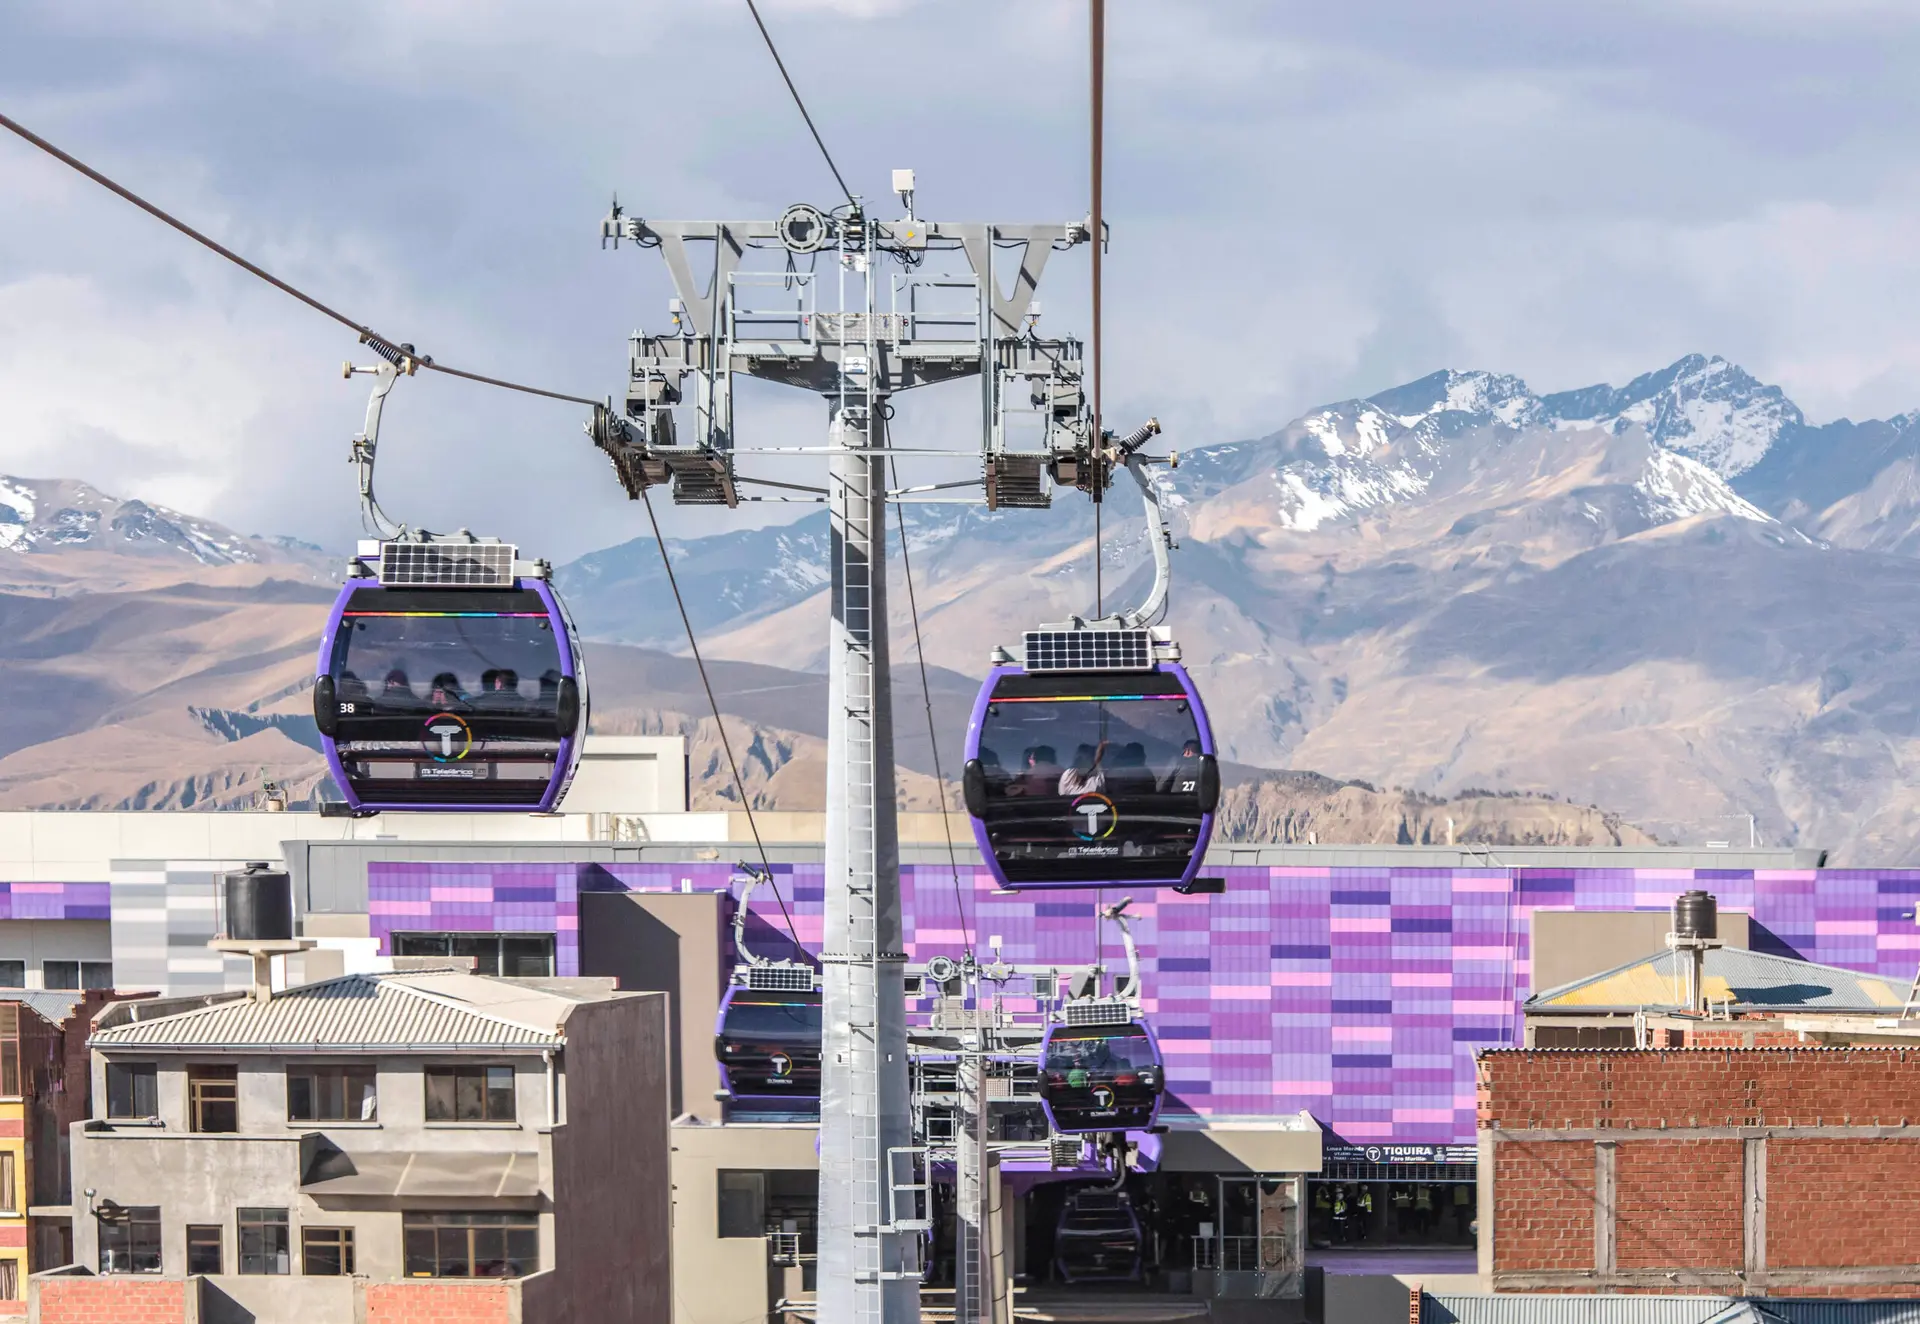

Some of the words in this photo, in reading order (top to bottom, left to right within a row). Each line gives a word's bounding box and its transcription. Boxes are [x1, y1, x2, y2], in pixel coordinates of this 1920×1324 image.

[340, 703, 355, 713] 38
[429, 725, 462, 757] T
[1182, 781, 1196, 791] 27
[1076, 803, 1108, 835] T
[1383, 1146, 1433, 1156] TIQUIRA
